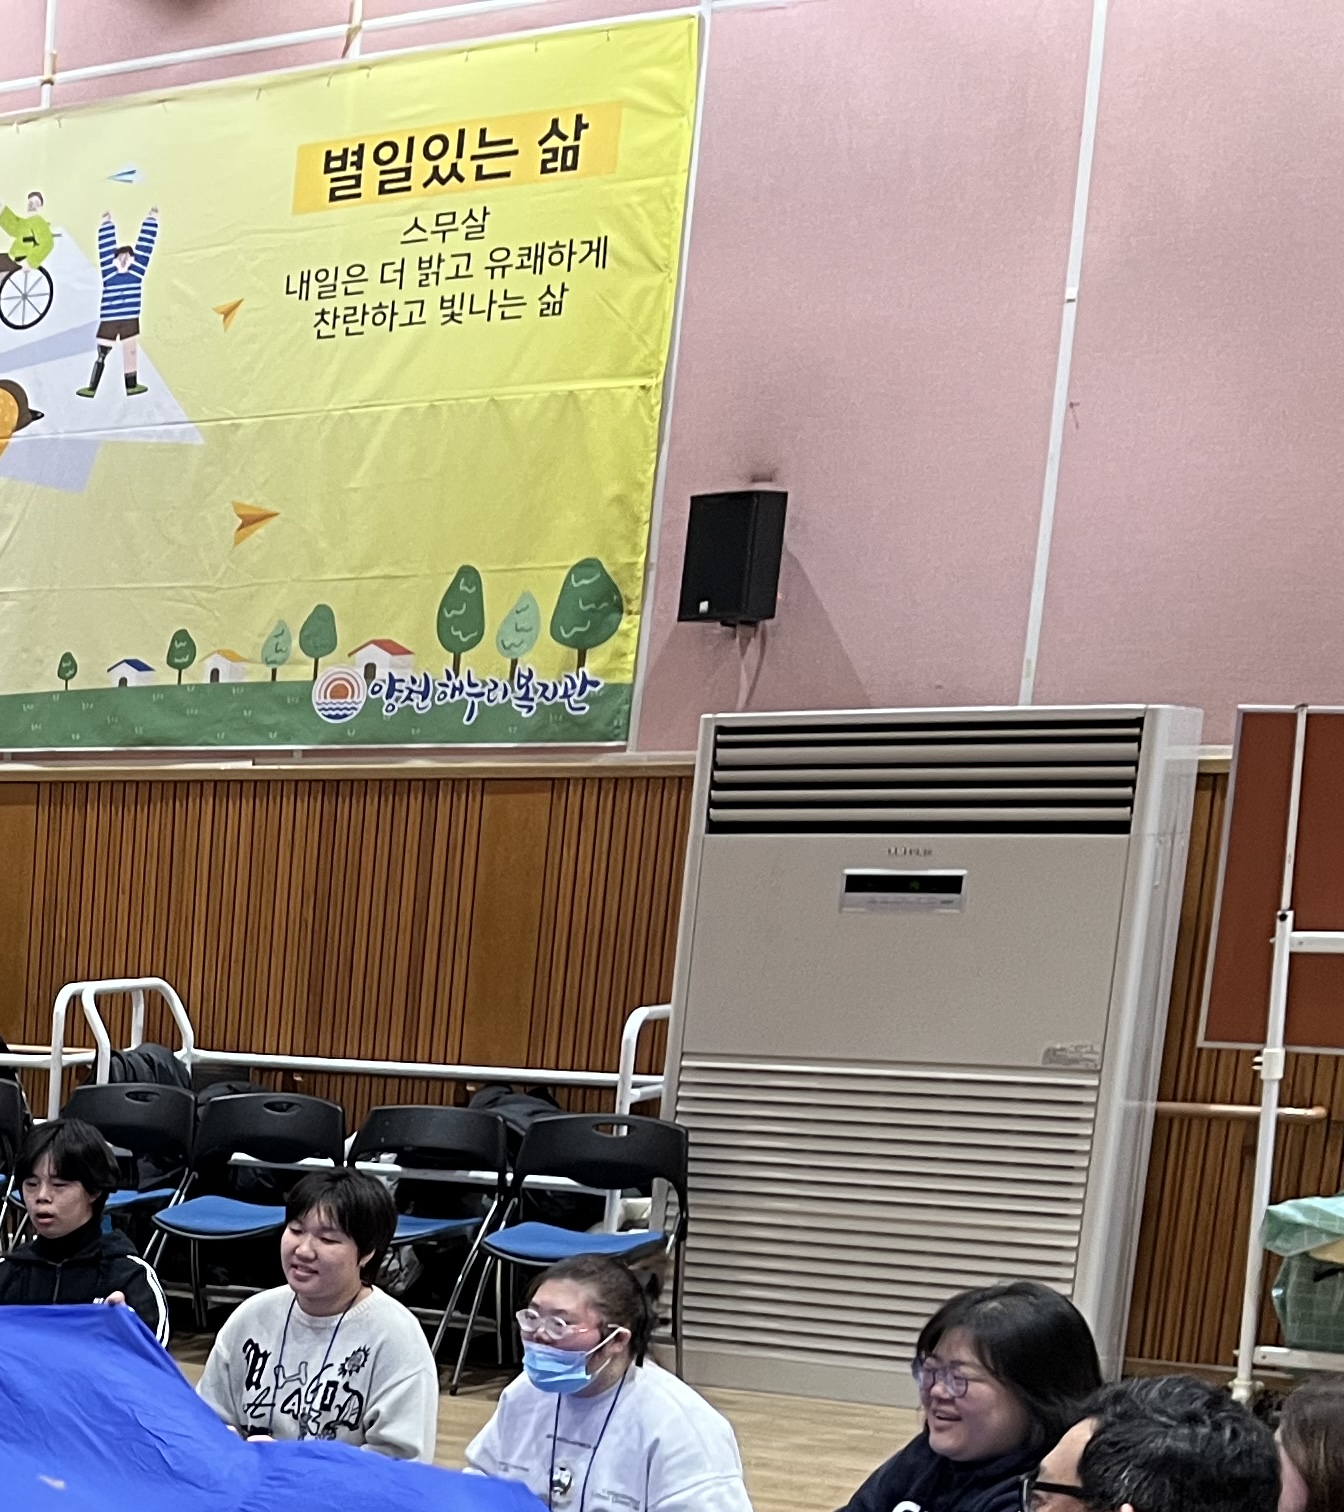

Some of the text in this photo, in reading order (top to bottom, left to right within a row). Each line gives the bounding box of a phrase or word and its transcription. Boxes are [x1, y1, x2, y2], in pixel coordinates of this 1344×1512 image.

[323, 113, 590, 202] 별일있는 삶
[400, 206, 491, 244] 스무살
[285, 235, 608, 301] 내일은 더 밝고 유쾌하게
[313, 281, 570, 339] 찬란하고 빛나는 삶
